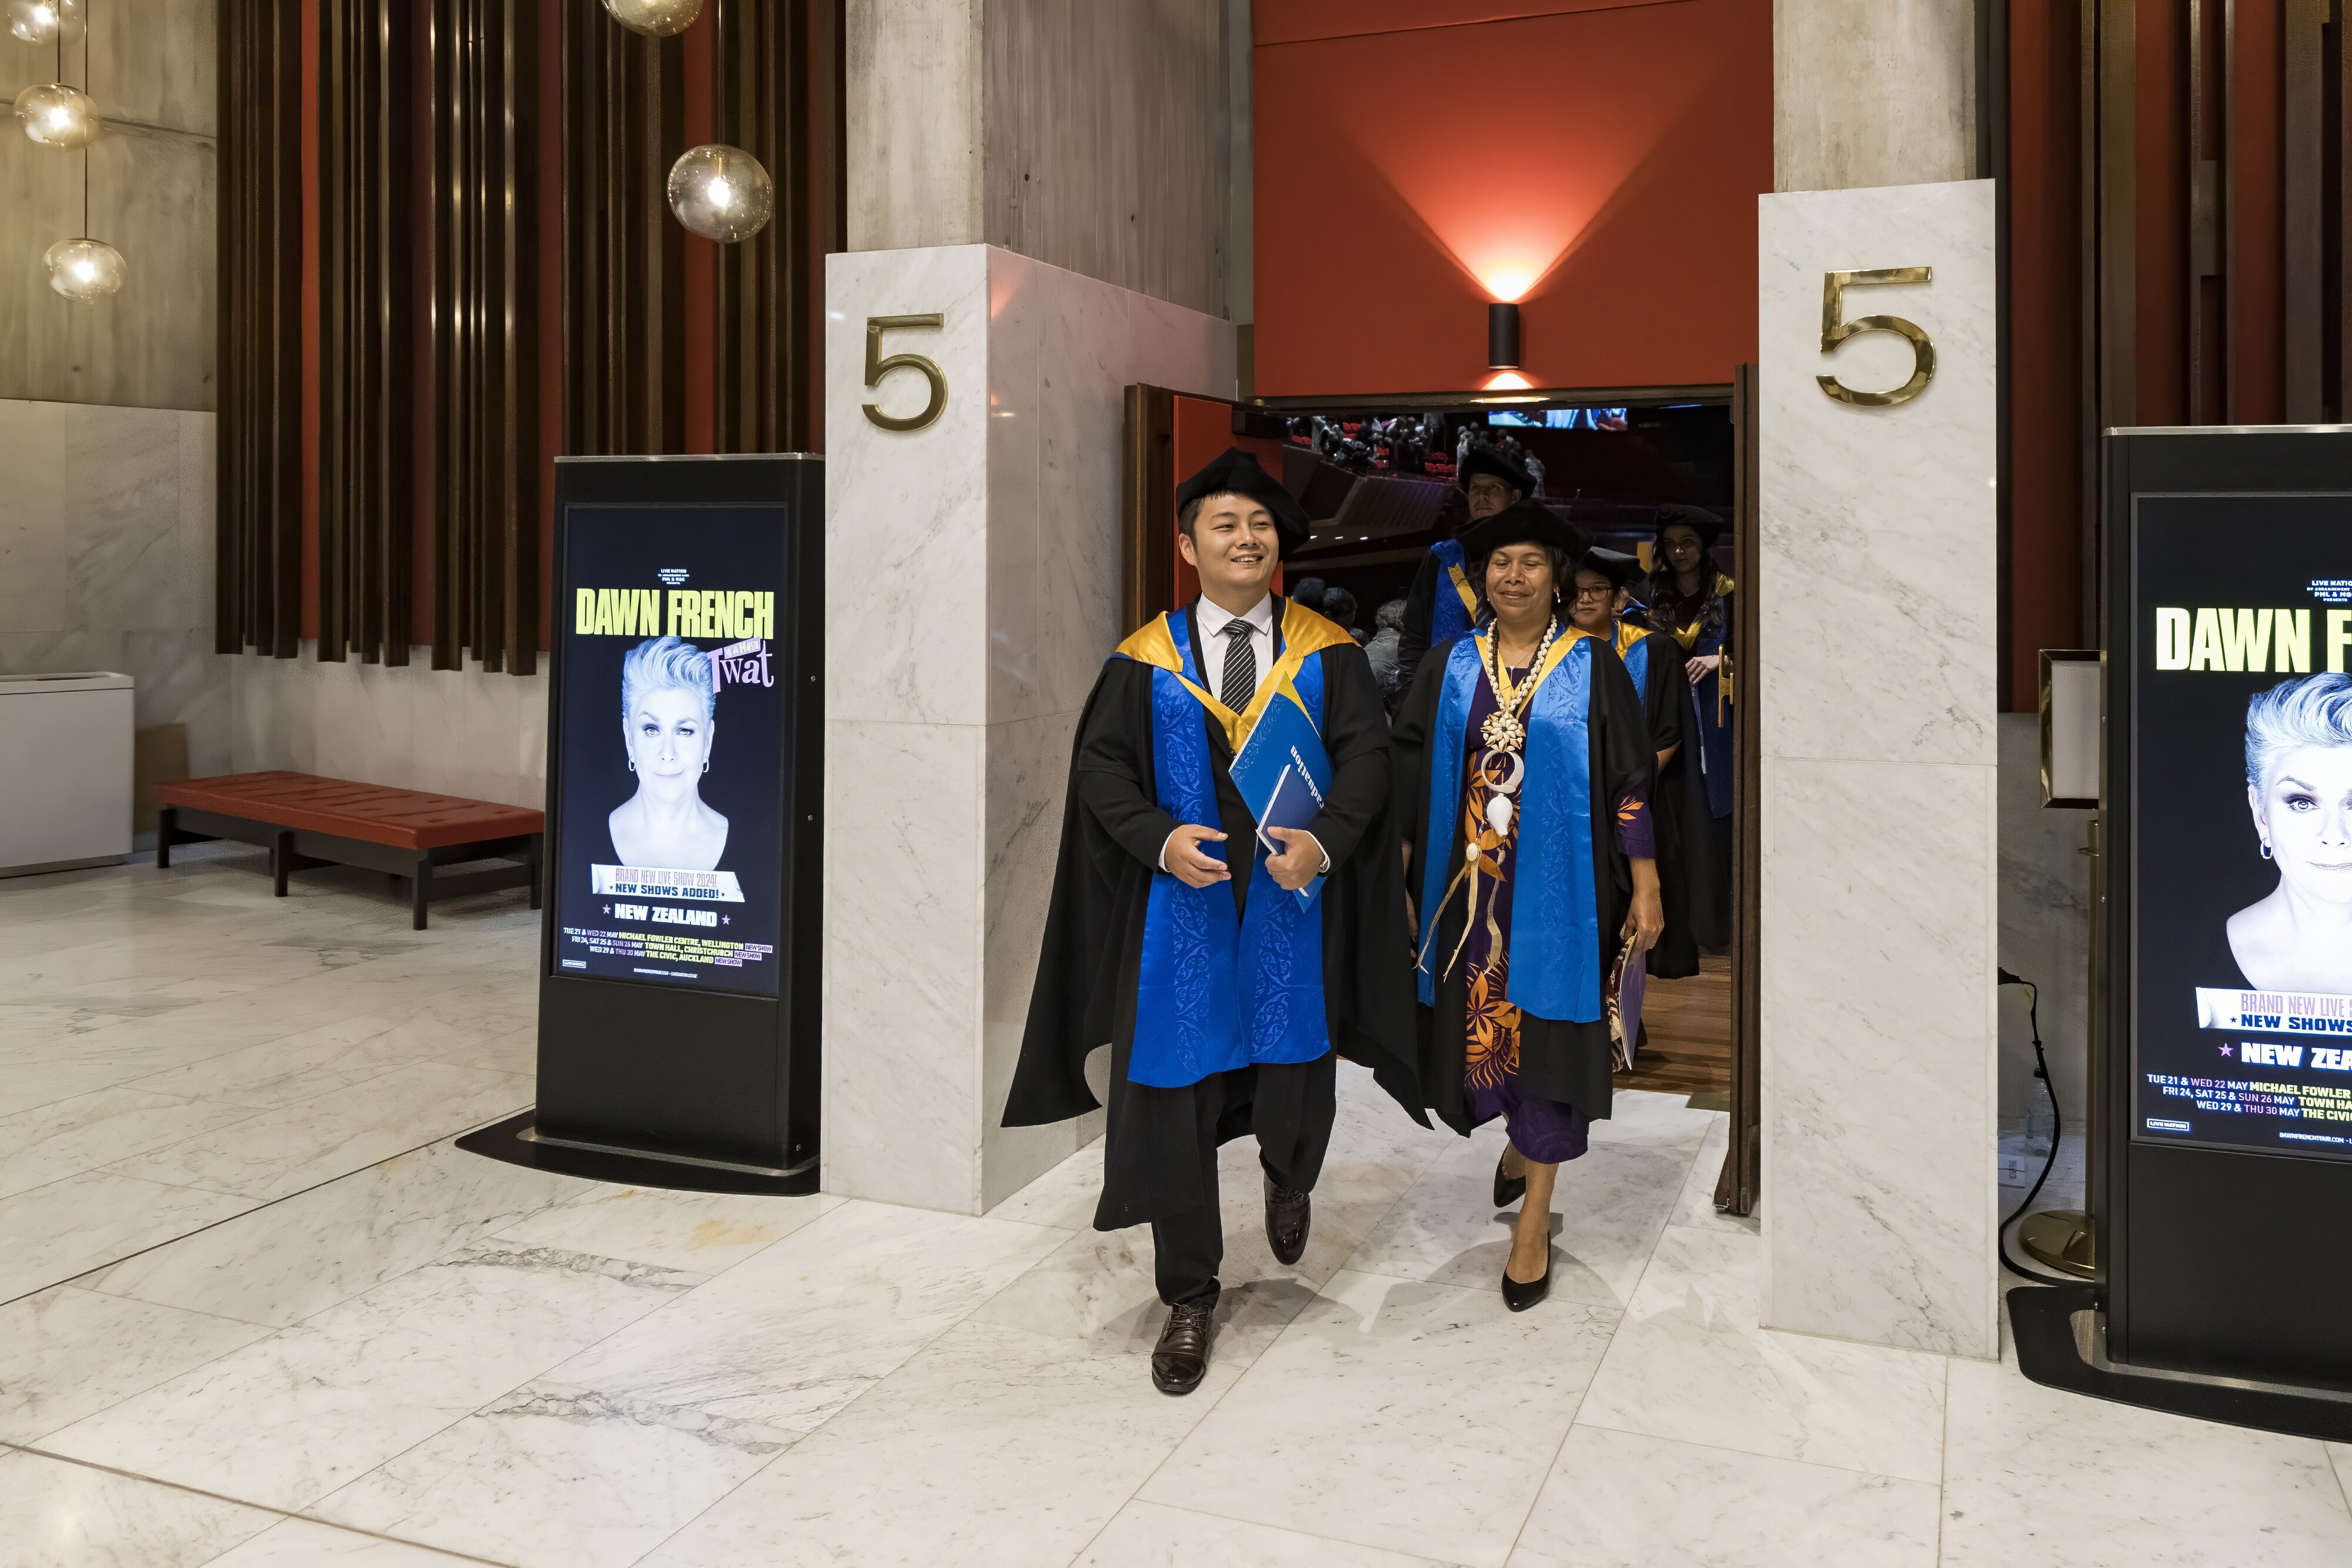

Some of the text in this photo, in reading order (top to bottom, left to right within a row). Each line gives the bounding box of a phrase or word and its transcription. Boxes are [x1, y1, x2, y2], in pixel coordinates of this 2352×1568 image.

[1816, 266, 1935, 406] 5
[861, 313, 948, 432] 5
[575, 588, 774, 639] DAWN FRENCH
[2156, 607, 2311, 673] DAWN
[1290, 745, 1325, 809] raduation
[616, 868, 717, 888] BRAND NEW LIVE SHOW 2024!
[615, 883, 719, 899] NEW SHOWS ADDED!
[615, 903, 718, 928] NEW ZEALAND
[618, 931, 646, 941] MICHAEL
[647, 934, 673, 943] FOWLER
[701, 939, 744, 950] WELLINGTON
[645, 942, 665, 950] TOWN
[684, 946, 733, 958] CHRISTCHURCH
[679, 953, 714, 964] AUCKLAND
[2241, 993, 2283, 1014] BRAND
[2288, 996, 2316, 1016] NEW
[2320, 997, 2344, 1017] LIVE
[2241, 1014, 2281, 1028] NEW
[2241, 1042, 2303, 1067] NEW
[2147, 1074, 2351, 1099] TUE 21 & WED 22 MAY MICHAEL FOWLER
[2163, 1086, 2178, 1096] FRI
[2180, 1088, 2194, 1098] 24,
[2195, 1089, 2214, 1098] SAT
[2215, 1090, 2226, 1099] 25
[2228, 1092, 2236, 1100] &
[2238, 1093, 2258, 1102] SUN
[2261, 1095, 2271, 1103] 26
[2274, 1095, 2295, 1105] MAY
[2298, 1096, 2334, 1109] TOWN
[2196, 1100, 2218, 1110] WED
[2220, 1102, 2231, 1111] 29
[2234, 1103, 2241, 1112] &
[2243, 1104, 2264, 1113] THU
[2266, 1106, 2277, 1115] 30
[2279, 1107, 2300, 1117] MAY
[2301, 1108, 2325, 1119] THE
